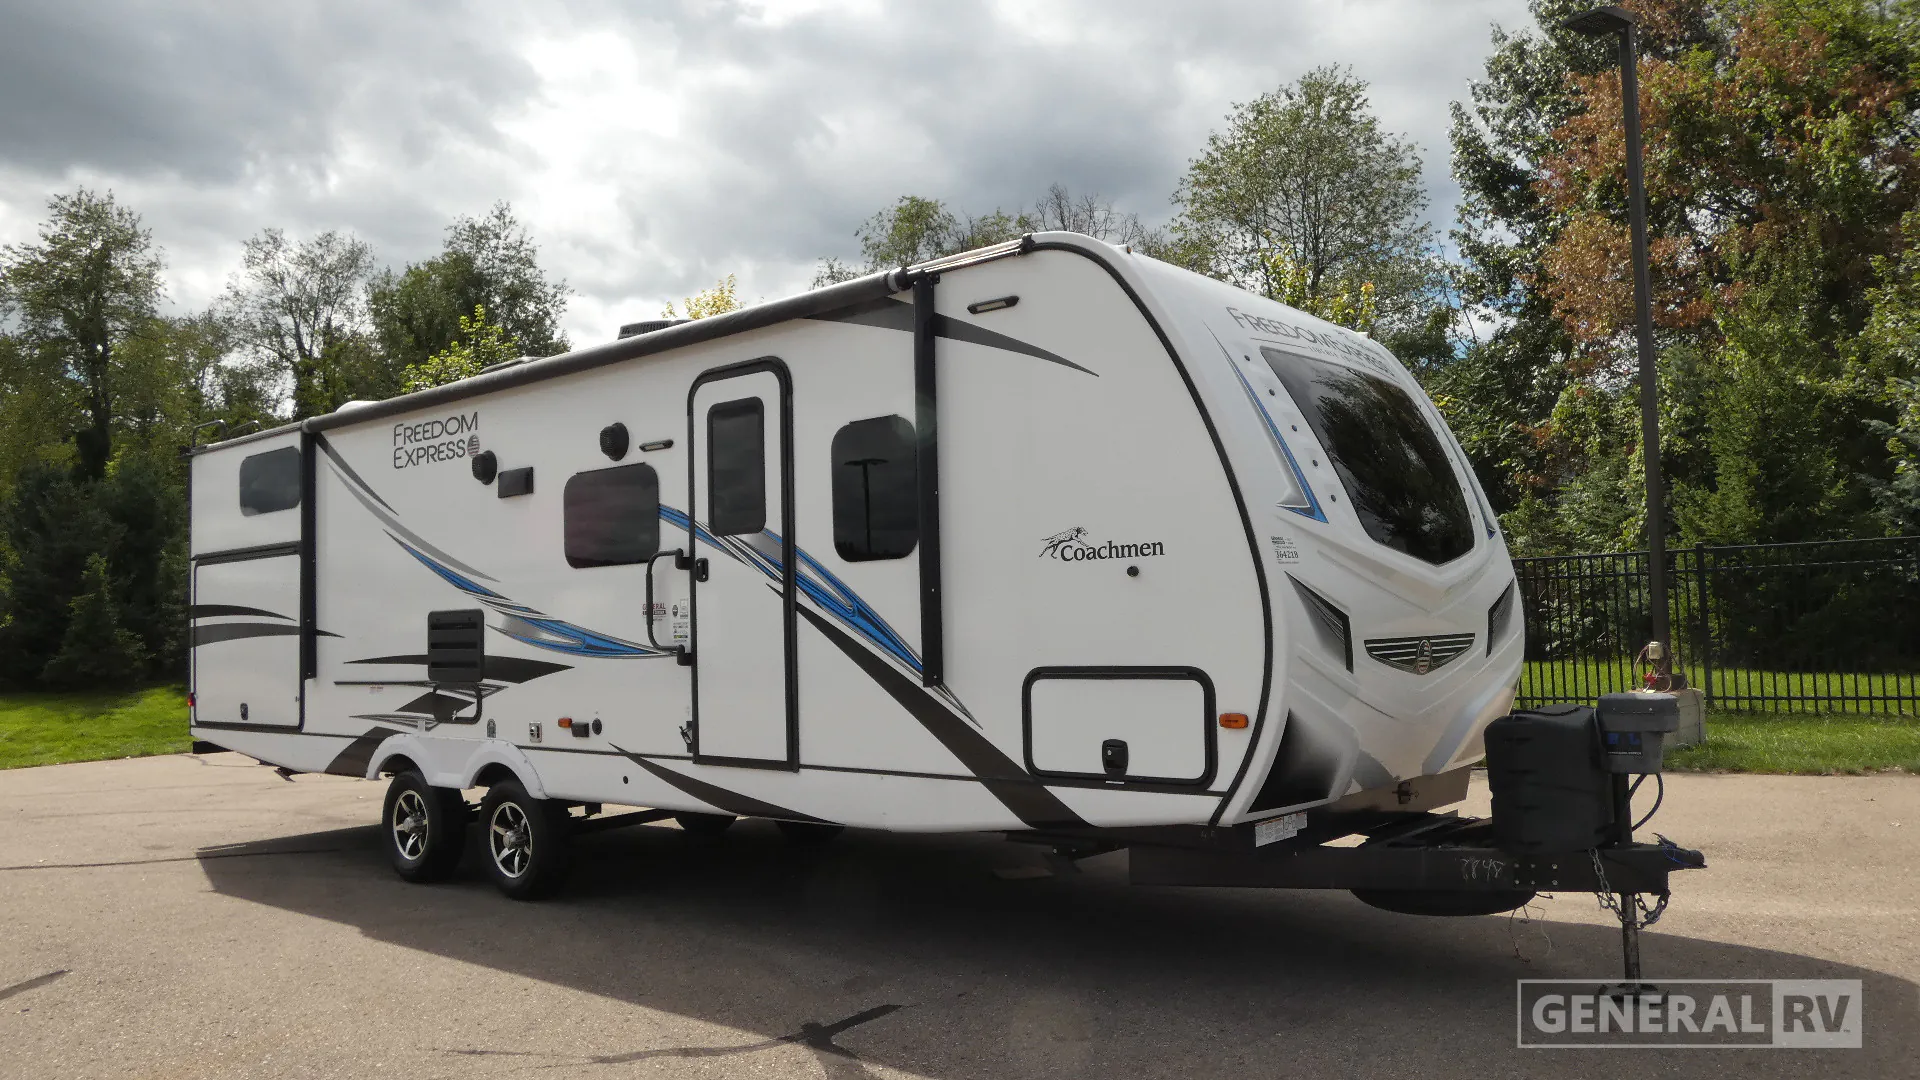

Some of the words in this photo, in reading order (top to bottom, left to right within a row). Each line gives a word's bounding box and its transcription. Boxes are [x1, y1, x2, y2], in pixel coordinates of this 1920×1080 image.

[1225, 306, 1331, 348] FREEDOM
[393, 411, 478, 446] FREEDOM
[393, 438, 466, 469] EXPRESS
[1060, 540, 1165, 562] Coachmen
